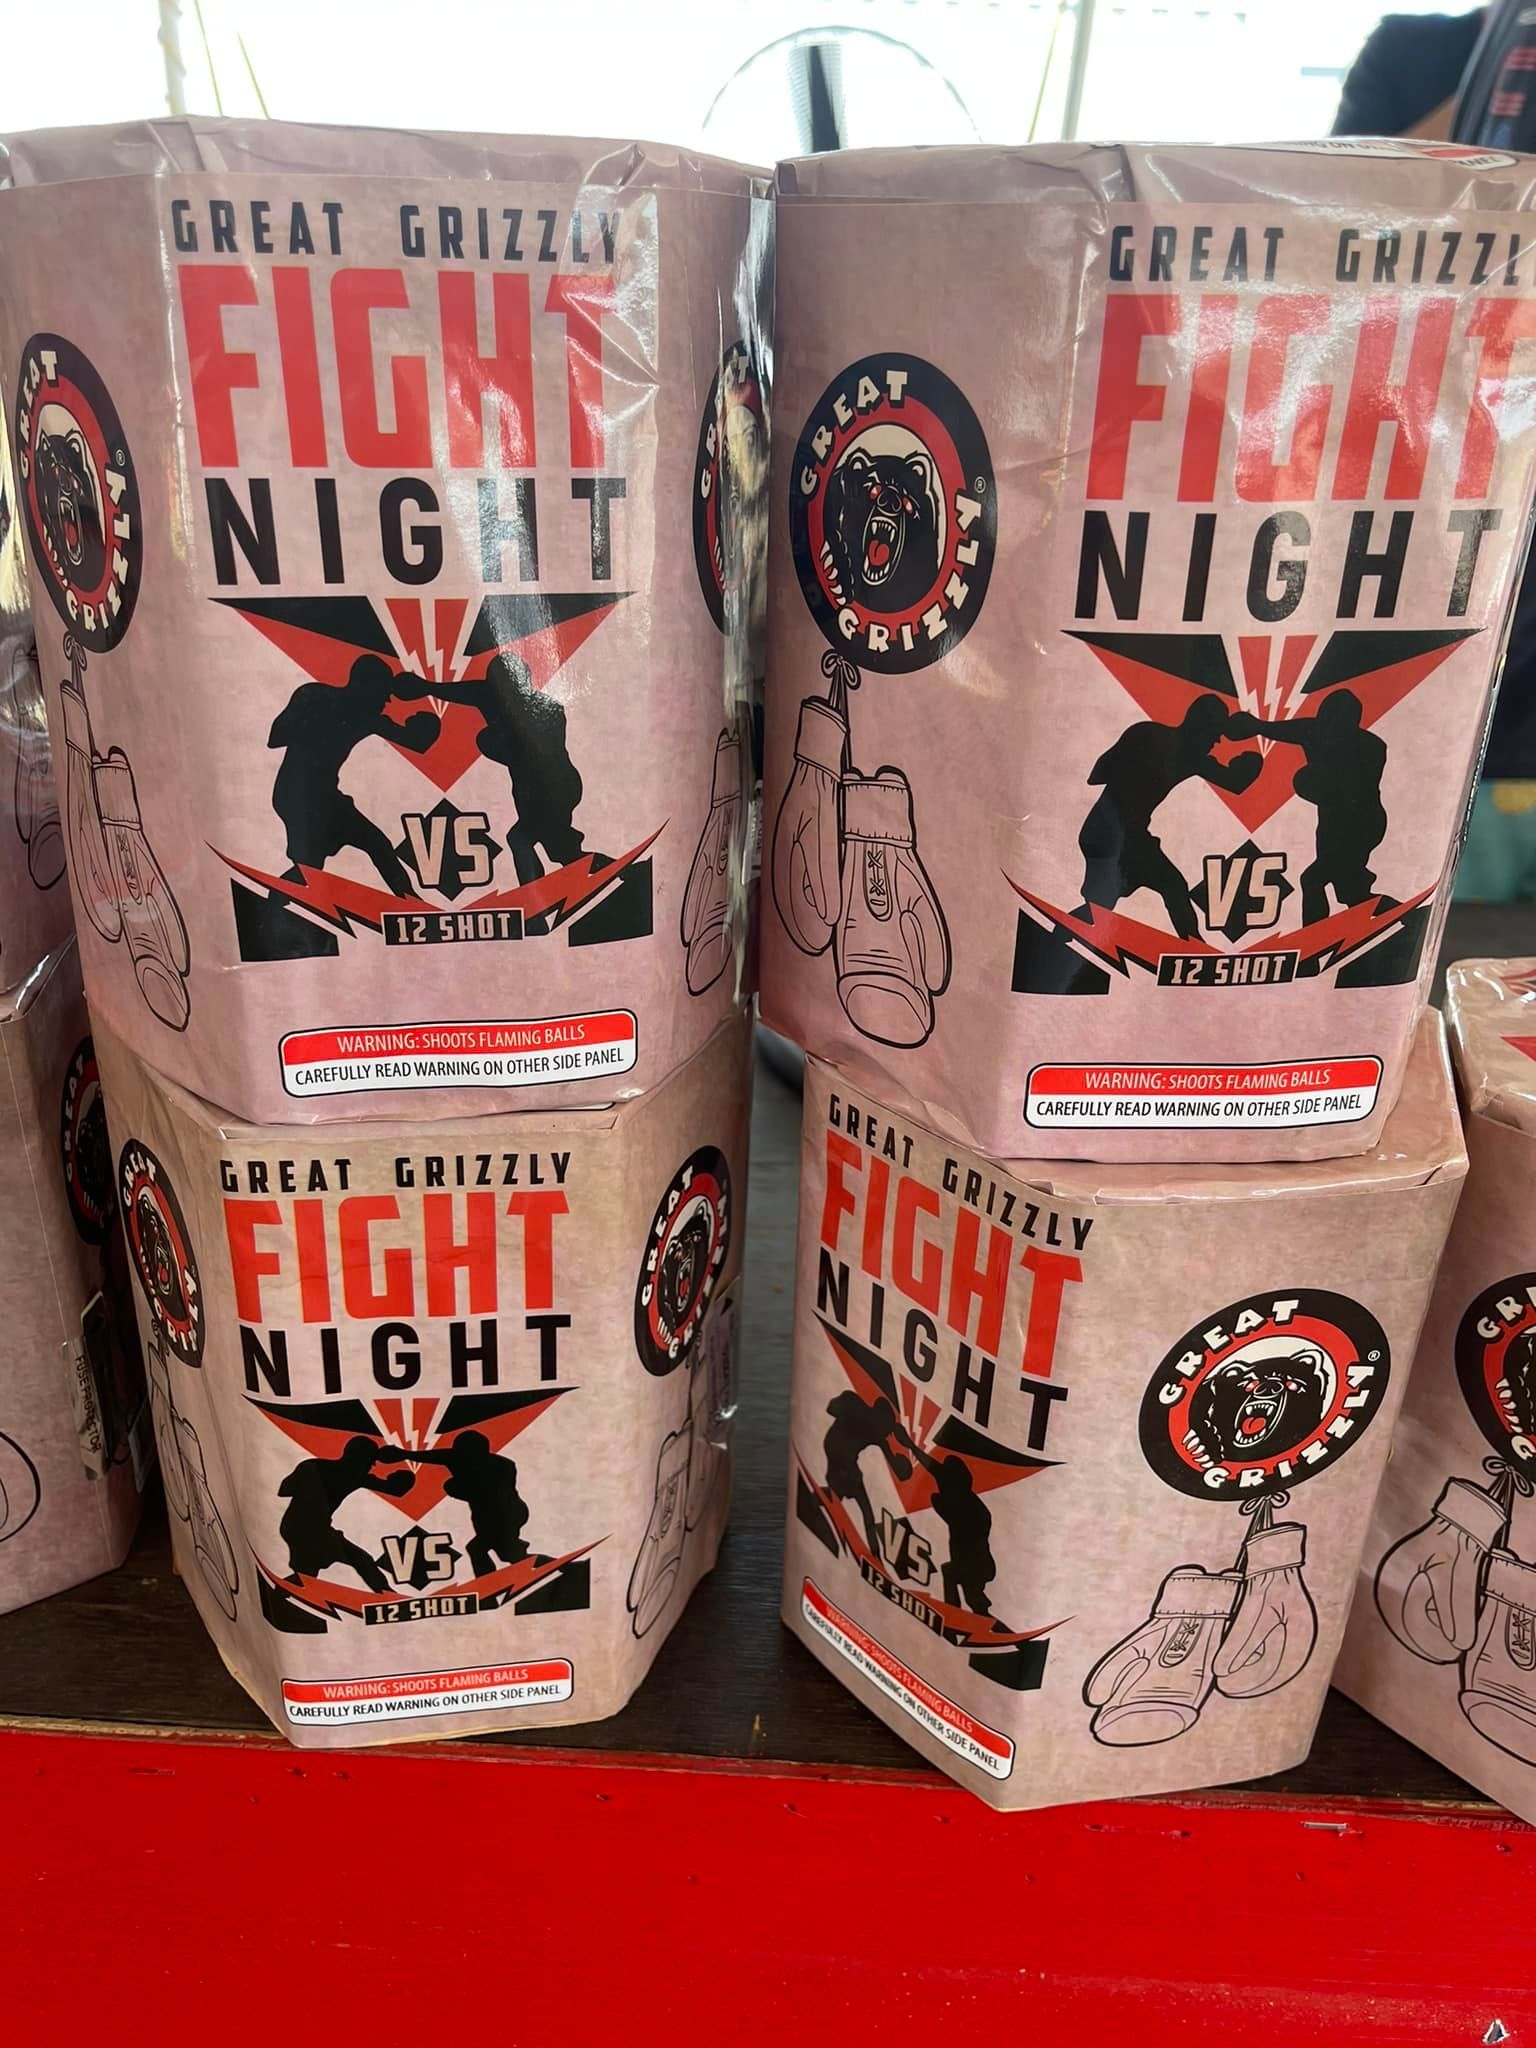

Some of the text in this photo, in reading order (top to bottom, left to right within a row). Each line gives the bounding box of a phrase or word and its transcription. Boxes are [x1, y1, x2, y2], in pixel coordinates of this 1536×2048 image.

[171, 199, 621, 264] GREAT GRIZZLY
[1109, 225, 1536, 287] GREAT GRIZZL
[178, 264, 620, 470] FIGHT
[1085, 293, 1536, 503] FIGHT
[19, 350, 131, 633] GREAT GRIZZLY
[800, 369, 983, 654] GREAT GRIZZLY
[206, 476, 627, 587] NIGHT
[1074, 509, 1504, 621] NIGHT
[403, 814, 491, 886] VS
[1205, 854, 1285, 929] VS
[396, 912, 511, 943] 12 SHOT
[1170, 955, 1287, 985] 12 SHOT
[295, 1047, 625, 1086] CAREFULLY READ WARNING ON OTHER SIDE PANEL
[336, 1023, 586, 1054] WARNING: SHOOTS FLAMING BALLS
[1036, 1093, 1363, 1117] CAREFULLY READ WARNING ON OTHER SIDE PANEL
[1084, 1068, 1331, 1090] WARNING: SHOOTS FLAMING BALLS
[123, 1151, 157, 1207] GREAT
[219, 1151, 571, 1194] GREAT GRIZZLY
[829, 1093, 1094, 1251] GREAT GRIZZLY
[224, 1190, 570, 1324] FIGHT
[641, 1165, 694, 1307] GREAT
[820, 1128, 1084, 1378] FIGHT
[75, 1354, 91, 1387] FUSE
[239, 1313, 572, 1398] NIGHT
[816, 1246, 1069, 1452] NIGHT
[1158, 1299, 1376, 1489] GREAT GRIZZLY
[383, 1534, 453, 1583] VS
[883, 1508, 931, 1586] VS
[375, 1597, 468, 1623] 12 SHOT
[867, 1565, 937, 1628] 12 SHOT
[289, 1684, 561, 1718] CAREFULLY READ WARNING ON OTHER SIDE PANEL
[323, 1669, 529, 1699] WARNING: SHOOTS FLAMING BALLS
[843, 1639, 864, 1664] READ
[864, 1660, 903, 1698] WARNING
[903, 1692, 916, 1710] ON
[916, 1702, 945, 1735] OTHER
[945, 1727, 969, 1750] SIDE
[969, 1742, 1000, 1771] PANEL
[903, 1673, 942, 1712] FLAMING
[942, 1706, 974, 1734] BALLS
